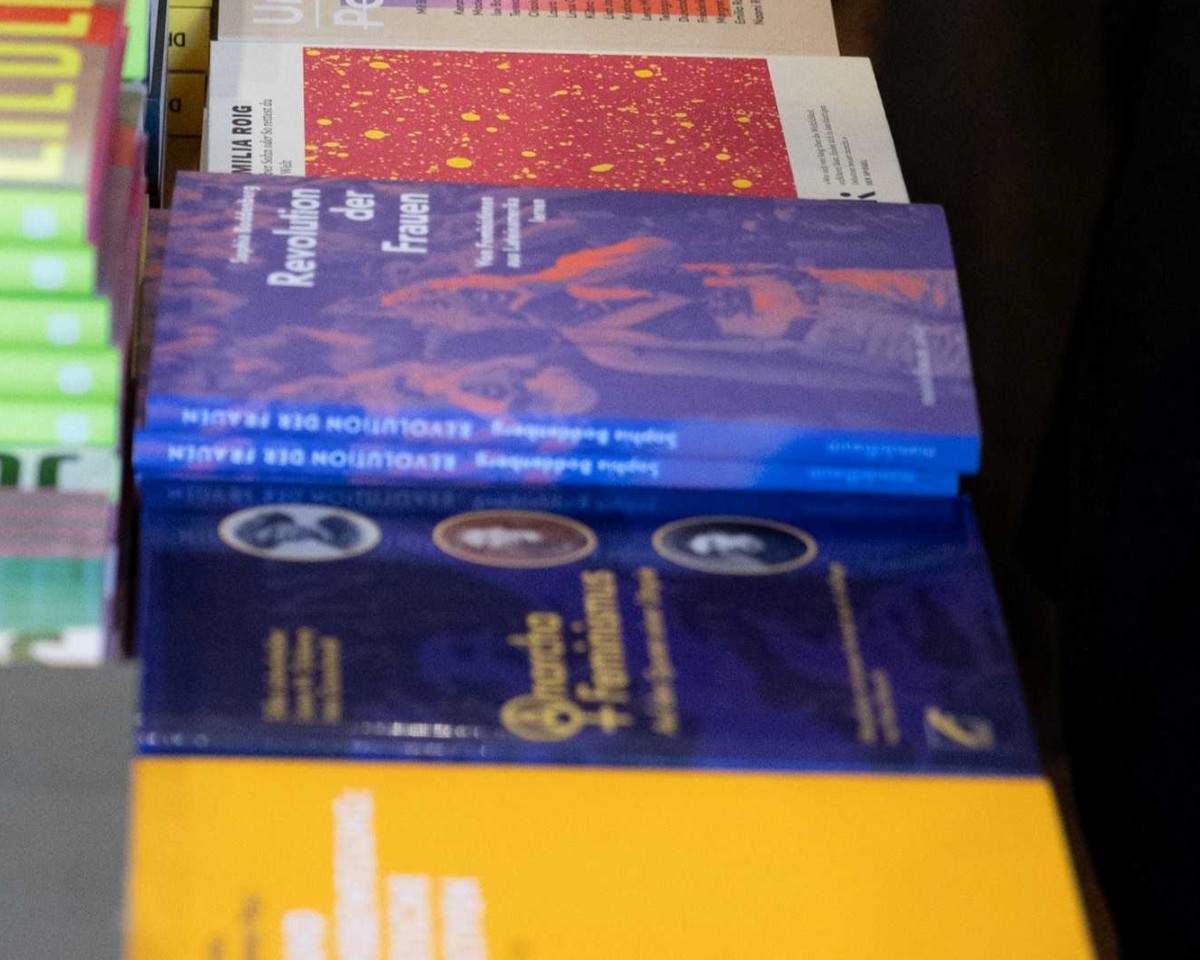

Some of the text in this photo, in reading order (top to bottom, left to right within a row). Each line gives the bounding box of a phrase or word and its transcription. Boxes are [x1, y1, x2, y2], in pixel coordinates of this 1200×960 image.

[733, 7, 745, 24] Emilia
[231, 105, 252, 173] MILIA ROIG
[329, 190, 376, 221] der
[381, 193, 429, 254] Frauen
[267, 188, 321, 288] Revolution
[181, 407, 269, 431] FRAUEN
[277, 411, 320, 434] DER
[325, 413, 471, 440] REVOLUTION
[168, 443, 253, 467] FRAUEN
[261, 445, 305, 470] DER
[309, 447, 457, 474] REVOLUTION
